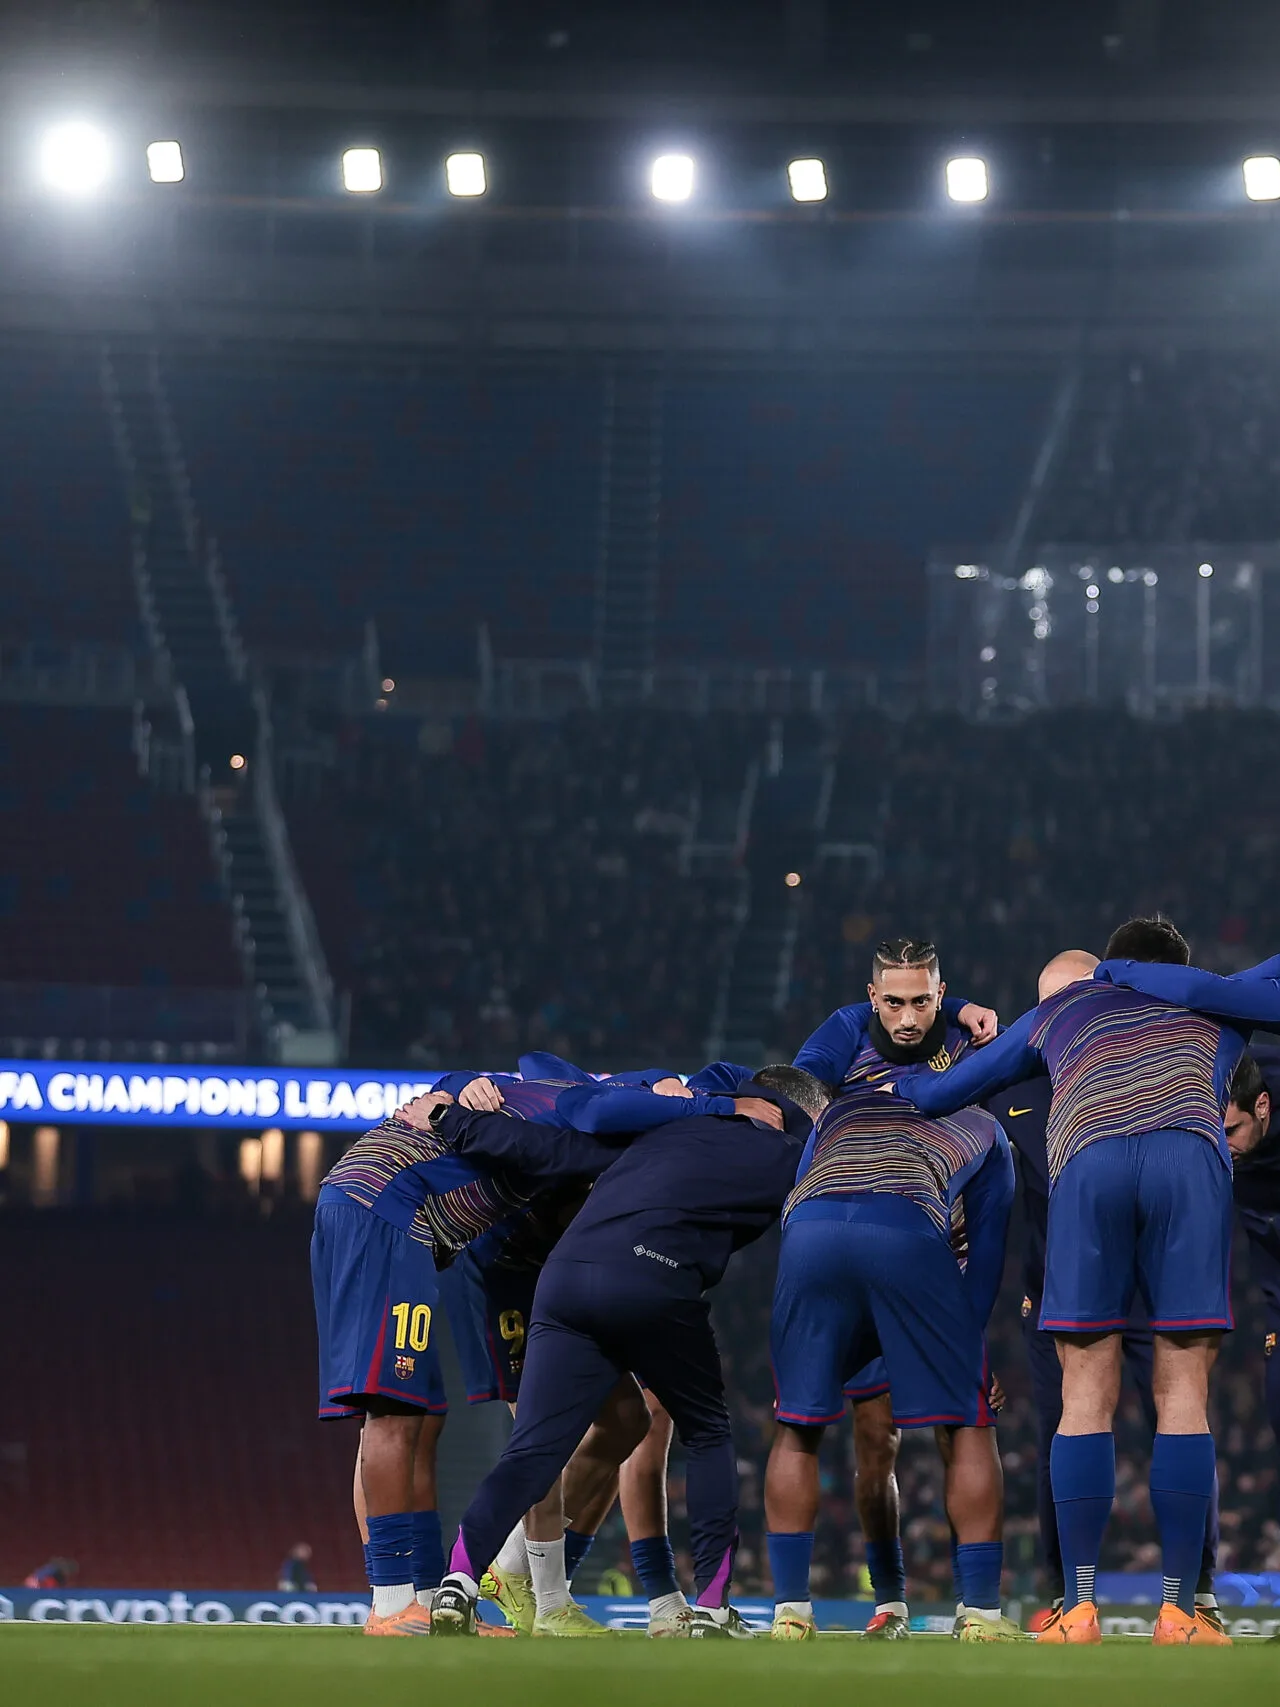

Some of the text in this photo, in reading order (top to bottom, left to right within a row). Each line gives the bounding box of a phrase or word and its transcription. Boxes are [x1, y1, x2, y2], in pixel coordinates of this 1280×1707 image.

[47, 1072, 280, 1117] CHAMPIONS
[646, 1249, 679, 1269] GORE-TEX
[392, 1302, 431, 1352] 10
[499, 1309, 524, 1354] 9
